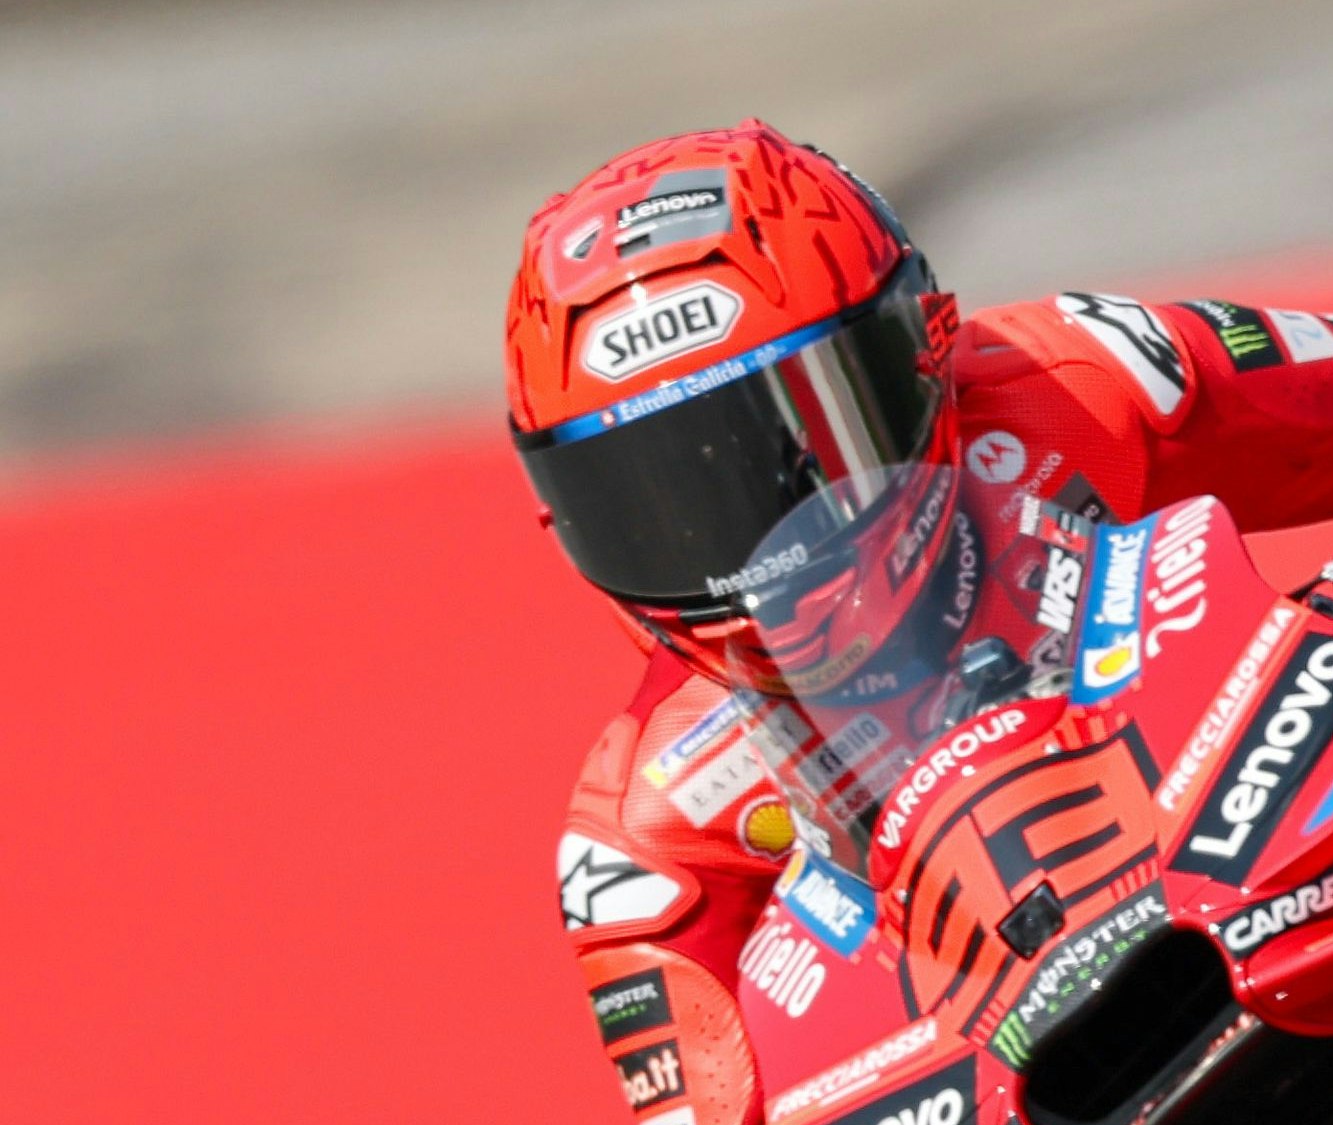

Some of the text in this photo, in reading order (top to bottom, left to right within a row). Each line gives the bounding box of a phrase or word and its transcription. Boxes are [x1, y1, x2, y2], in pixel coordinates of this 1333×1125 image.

[602, 296, 718, 367] SHOEI
[685, 358, 747, 397] Galicia
[705, 543, 808, 598] Insta360
[942, 510, 977, 630] Lenovo
[1037, 547, 1083, 634] WRS
[1157, 606, 1297, 811] FRECCIAROSSA
[876, 707, 1026, 849] VARGROUP
[1018, 895, 1167, 1023] MONSTER
